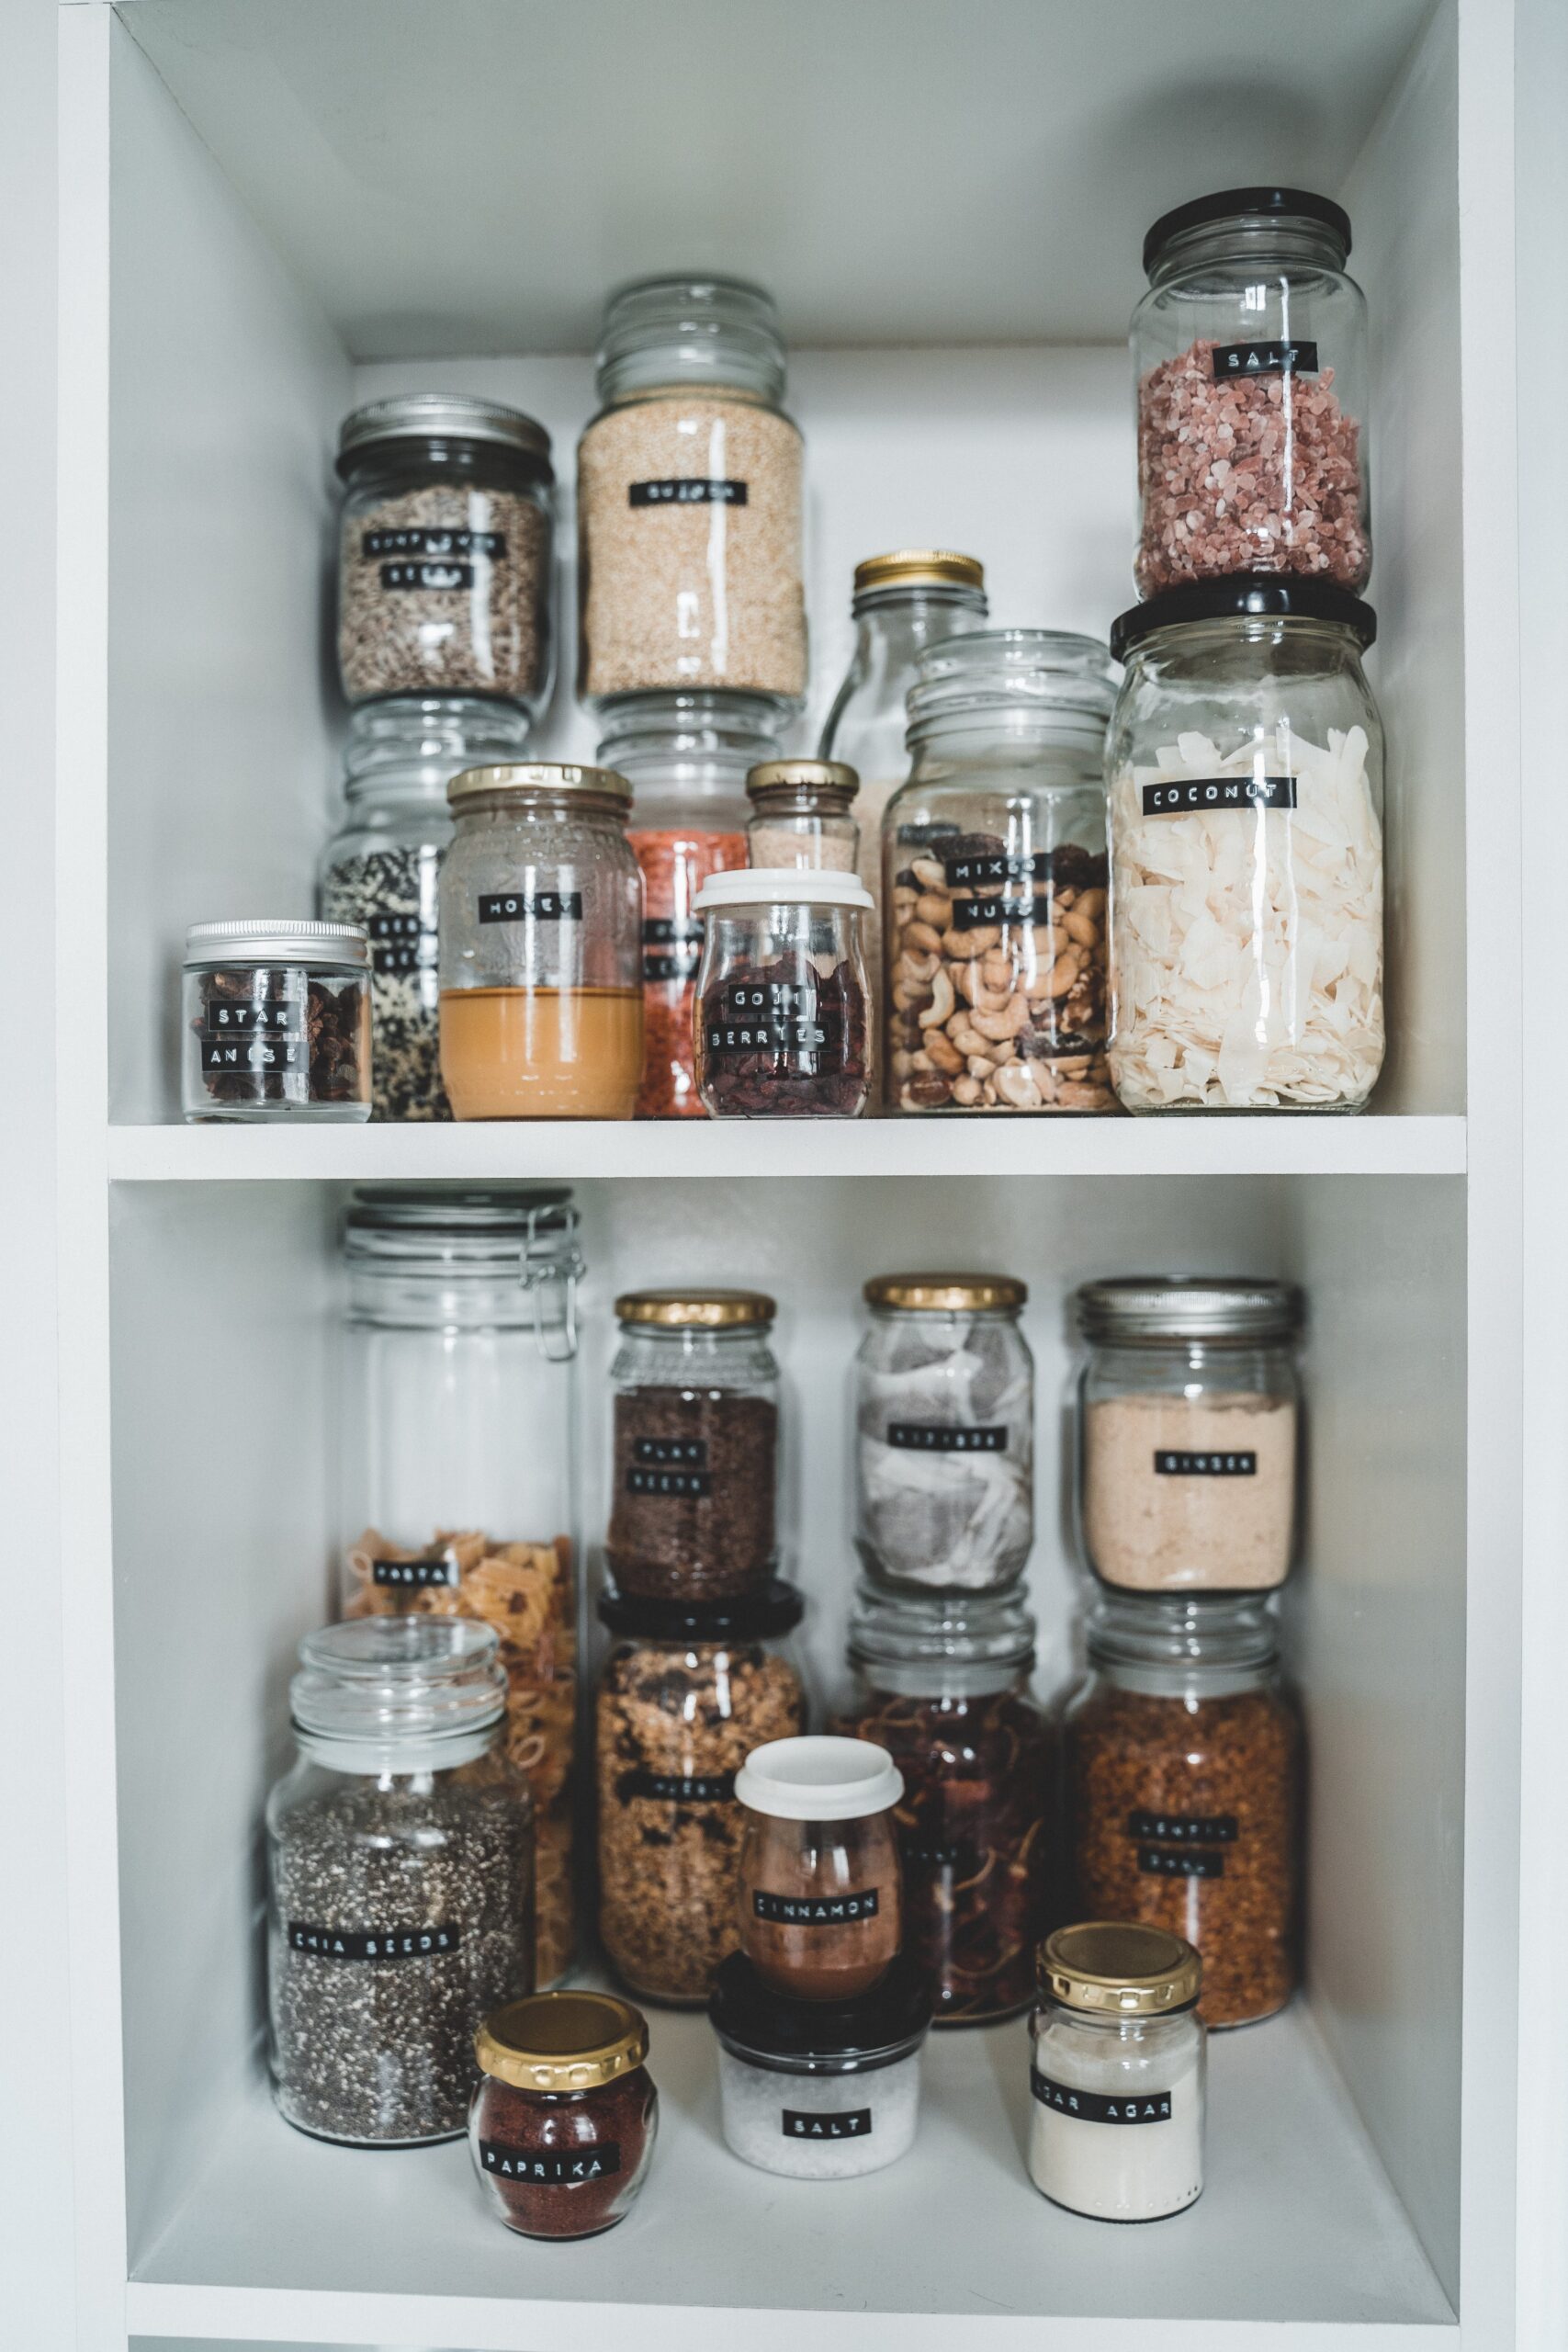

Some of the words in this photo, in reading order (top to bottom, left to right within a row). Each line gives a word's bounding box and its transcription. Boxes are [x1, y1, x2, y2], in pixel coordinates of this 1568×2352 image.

[1227, 349, 1300, 368] SALT
[1153, 783, 1278, 807] COCONUT
[955, 857, 1036, 879] MIXED
[490, 897, 573, 915] HONEY
[967, 901, 1033, 919] NUTS
[734, 989, 801, 1006] GOJI
[218, 1008, 288, 1027] STAR
[210, 1046, 297, 1065] ANISE
[757, 1895, 874, 1917] CINNAMON
[295, 1931, 345, 1953] CHIA
[366, 1933, 449, 1955] SEEDS
[1105, 2100, 1169, 2119] AGAR
[793, 2117, 860, 2135] SALT
[486, 2151, 602, 2177] PAPRIKA
